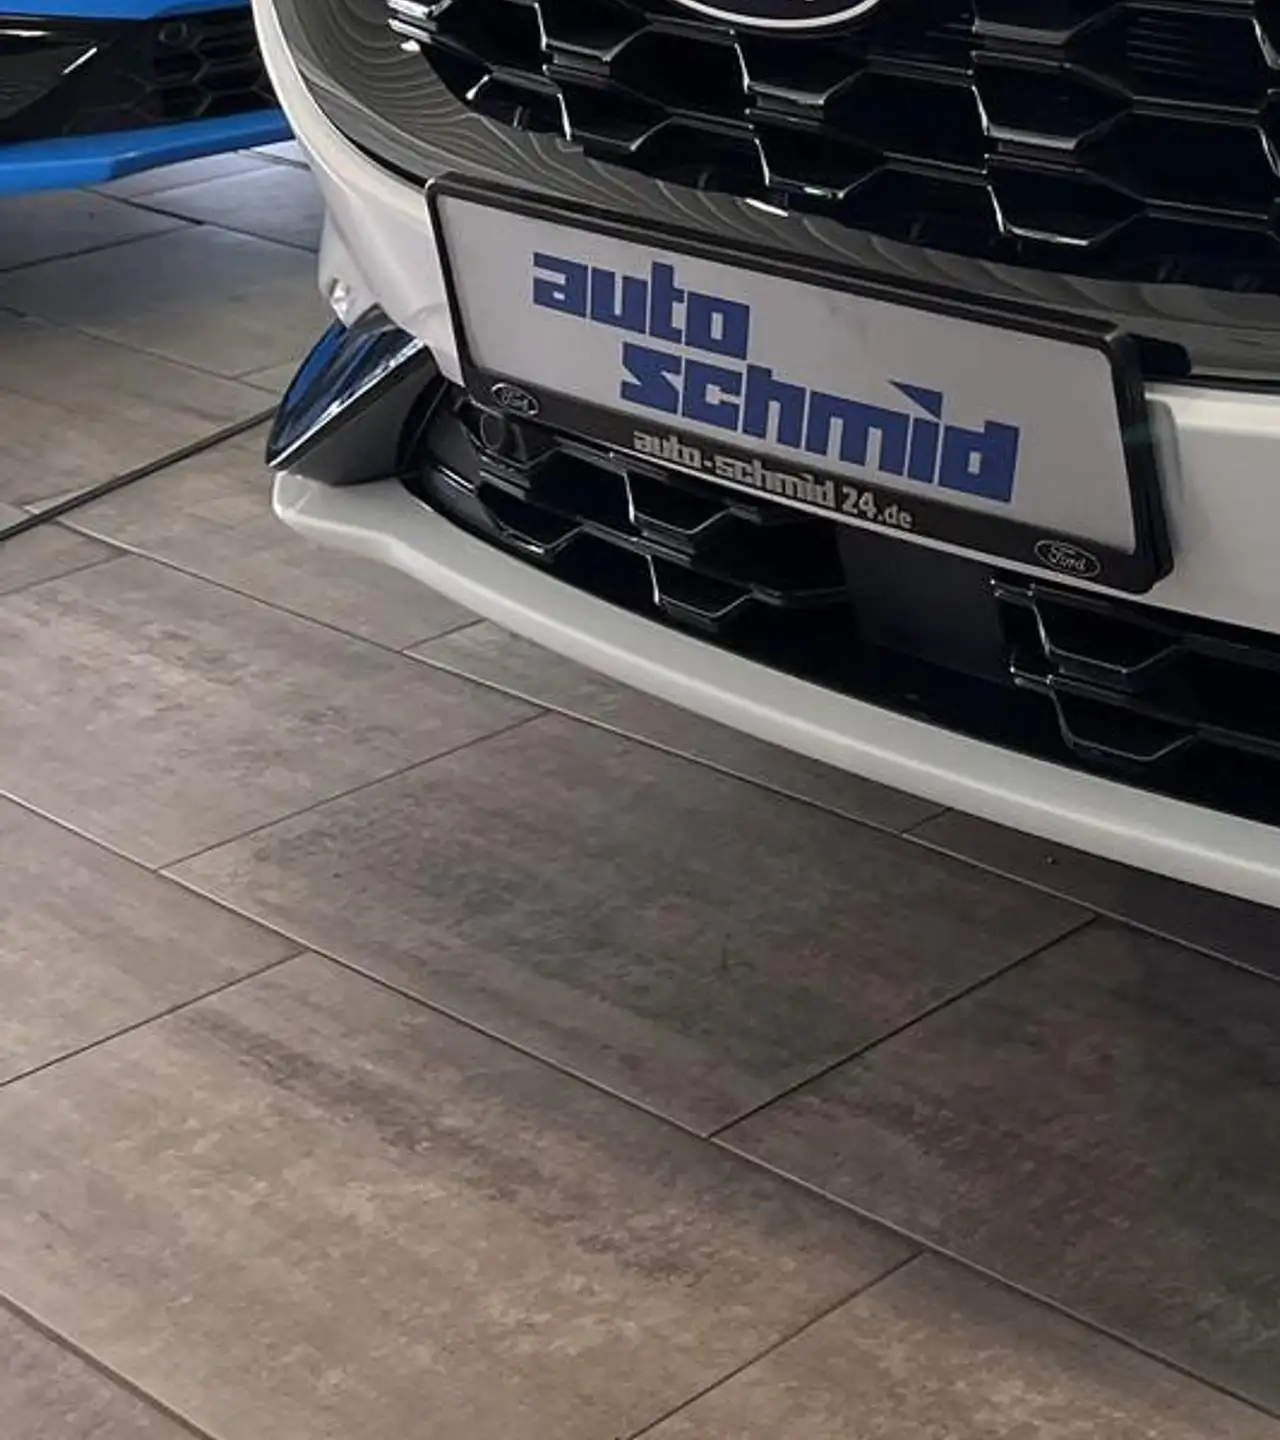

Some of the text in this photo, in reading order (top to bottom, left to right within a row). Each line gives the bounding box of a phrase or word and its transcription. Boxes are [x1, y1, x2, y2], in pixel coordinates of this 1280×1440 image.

[533, 252, 750, 359] auto
[621, 342, 1020, 504] schmid
[841, 486, 913, 529] 24.de
[1046, 545, 1088, 572] Ford
